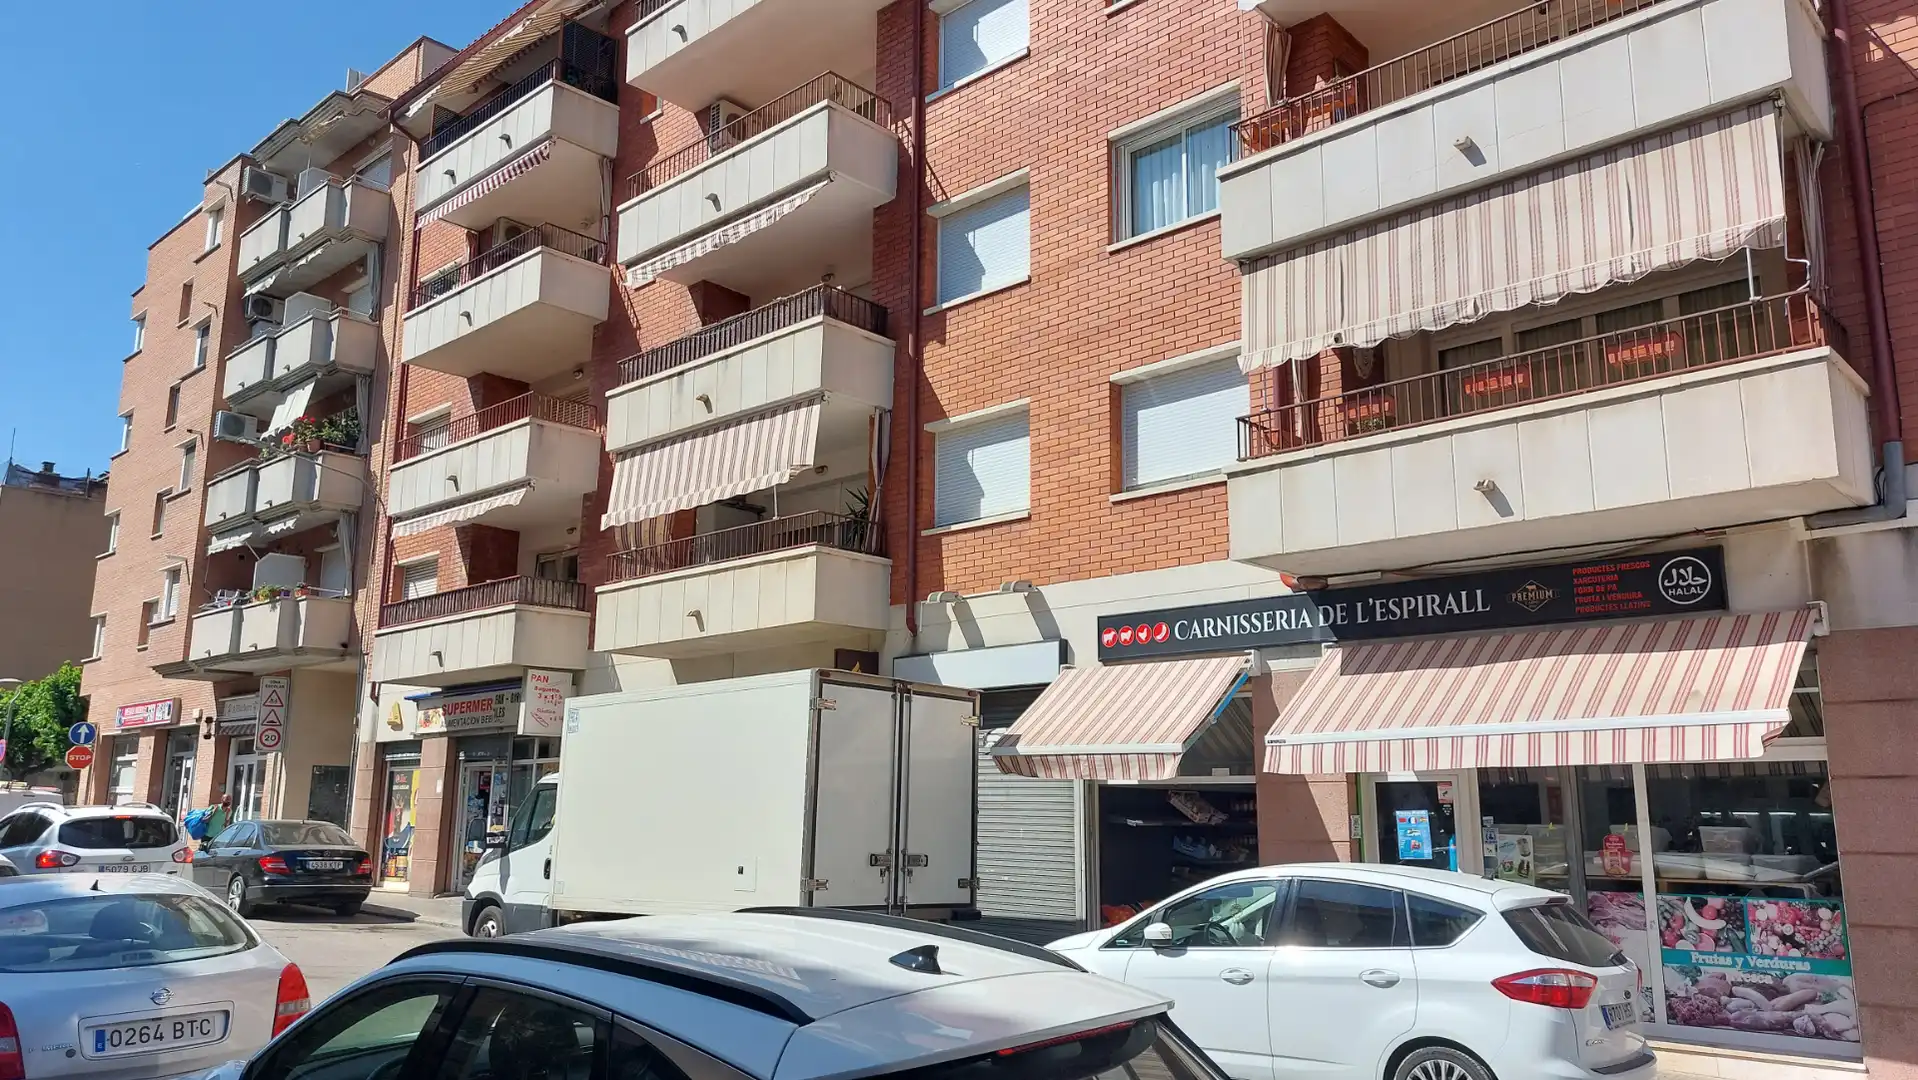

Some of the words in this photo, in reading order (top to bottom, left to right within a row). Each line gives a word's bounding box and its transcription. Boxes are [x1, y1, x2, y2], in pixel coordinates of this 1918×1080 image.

[1616, 560, 1651, 571] FRESCOS
[1663, 566, 1707, 586] حلال
[1606, 583, 1618, 592] PA
[1668, 586, 1704, 597] HALAL
[1511, 589, 1553, 602] PREMIUM
[1174, 606, 1313, 642] CARNISSERIA
[1317, 602, 1348, 628] DE
[1355, 588, 1491, 624] L'ESPIRALL
[531, 673, 549, 683] PAN
[442, 698, 493, 717] SUPERMER
[264, 734, 277, 742] 20
[1690, 951, 1733, 966] Frutas
[1734, 956, 1744, 971] y
[1746, 955, 1811, 971] Verduras
[109, 1023, 164, 1048] 0264
[173, 1018, 211, 1040] BTC
